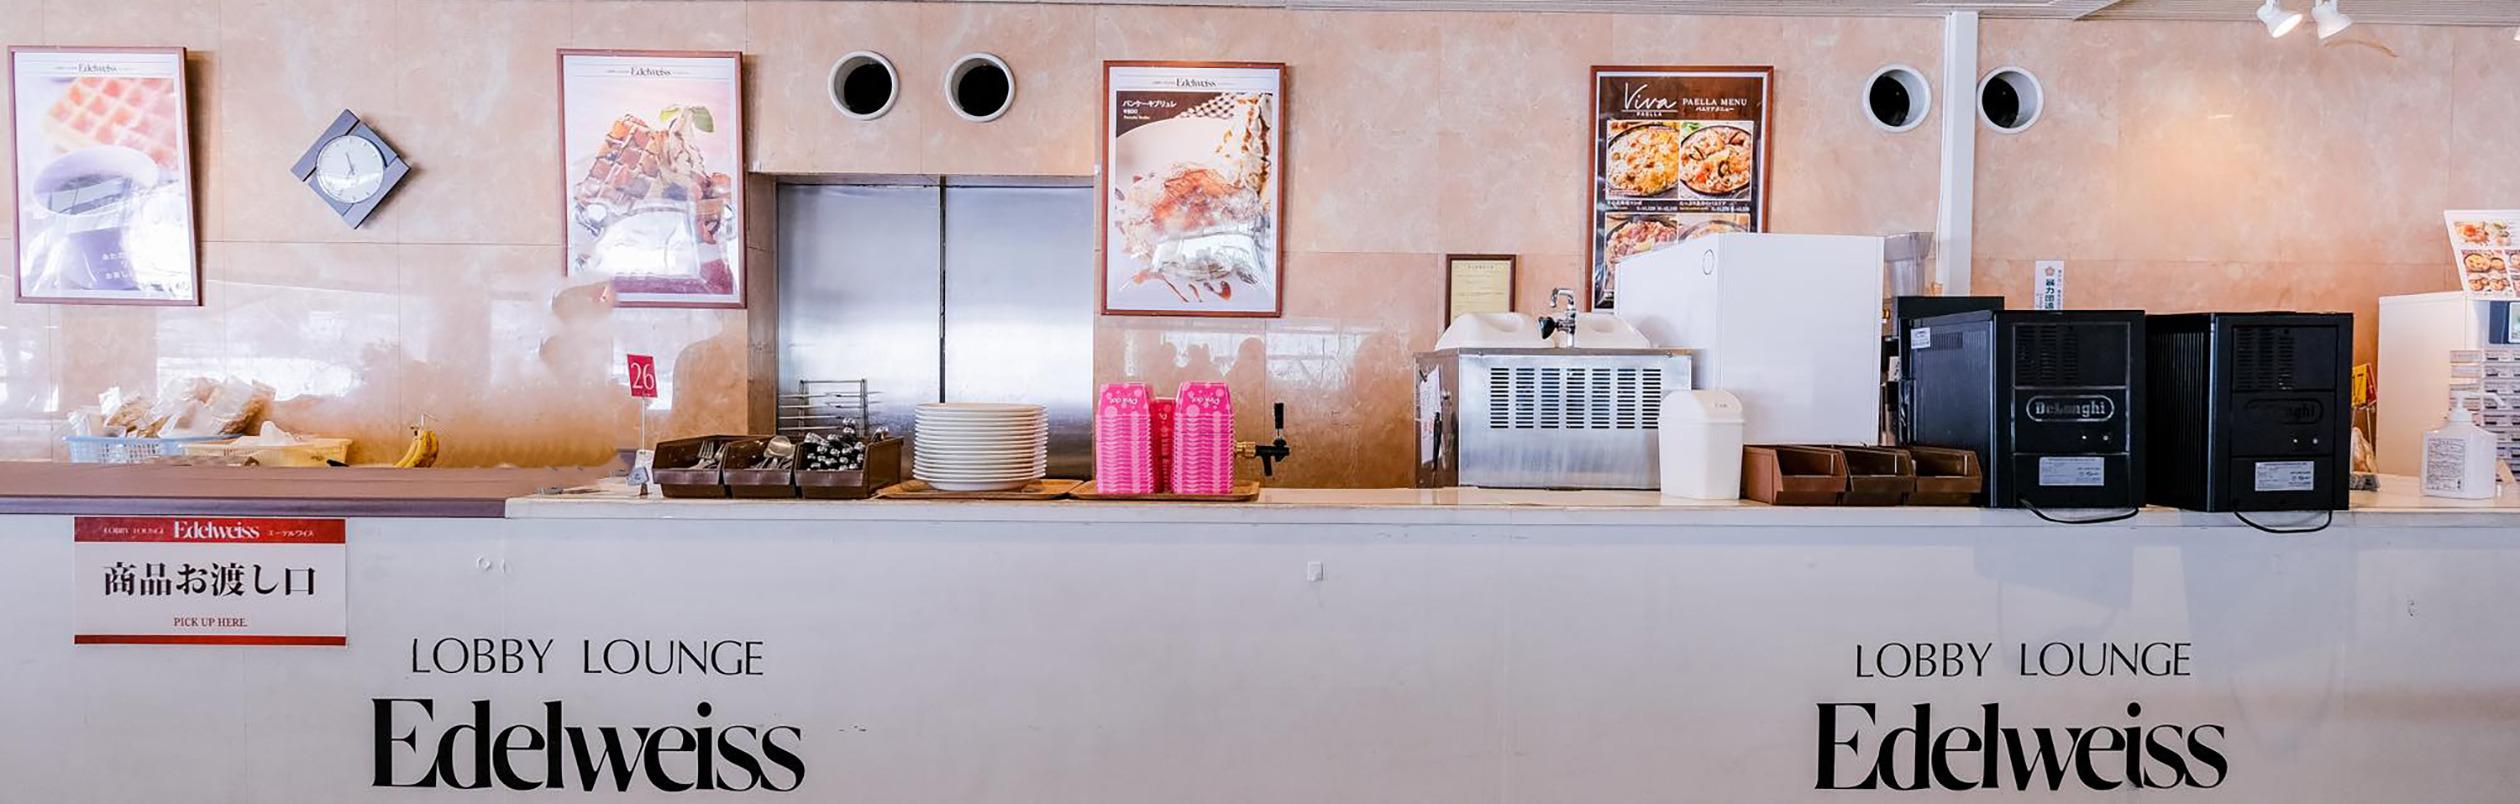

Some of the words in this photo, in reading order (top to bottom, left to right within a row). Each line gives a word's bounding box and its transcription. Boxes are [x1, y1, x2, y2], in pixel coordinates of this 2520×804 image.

[631, 66, 672, 76] Edelweiss
[1176, 78, 1217, 87] Edelweiss
[1624, 82, 1677, 110] Viva
[1682, 97, 1717, 106] PAELLA
[1720, 97, 1748, 106] MENU
[630, 362, 655, 390] 26
[172, 520, 260, 539] Edelweiss
[103, 561, 316, 597] 商品お渡し口
[174, 617, 199, 627] PICK
[201, 617, 215, 627] UP
[412, 637, 554, 674] LOBBY
[583, 639, 764, 676] LOUNGE
[1856, 642, 1993, 678] LOBBY
[2020, 642, 2192, 677] LOUNGE
[371, 698, 806, 792] Edelweiss
[1814, 702, 2229, 791] Edelweiss
